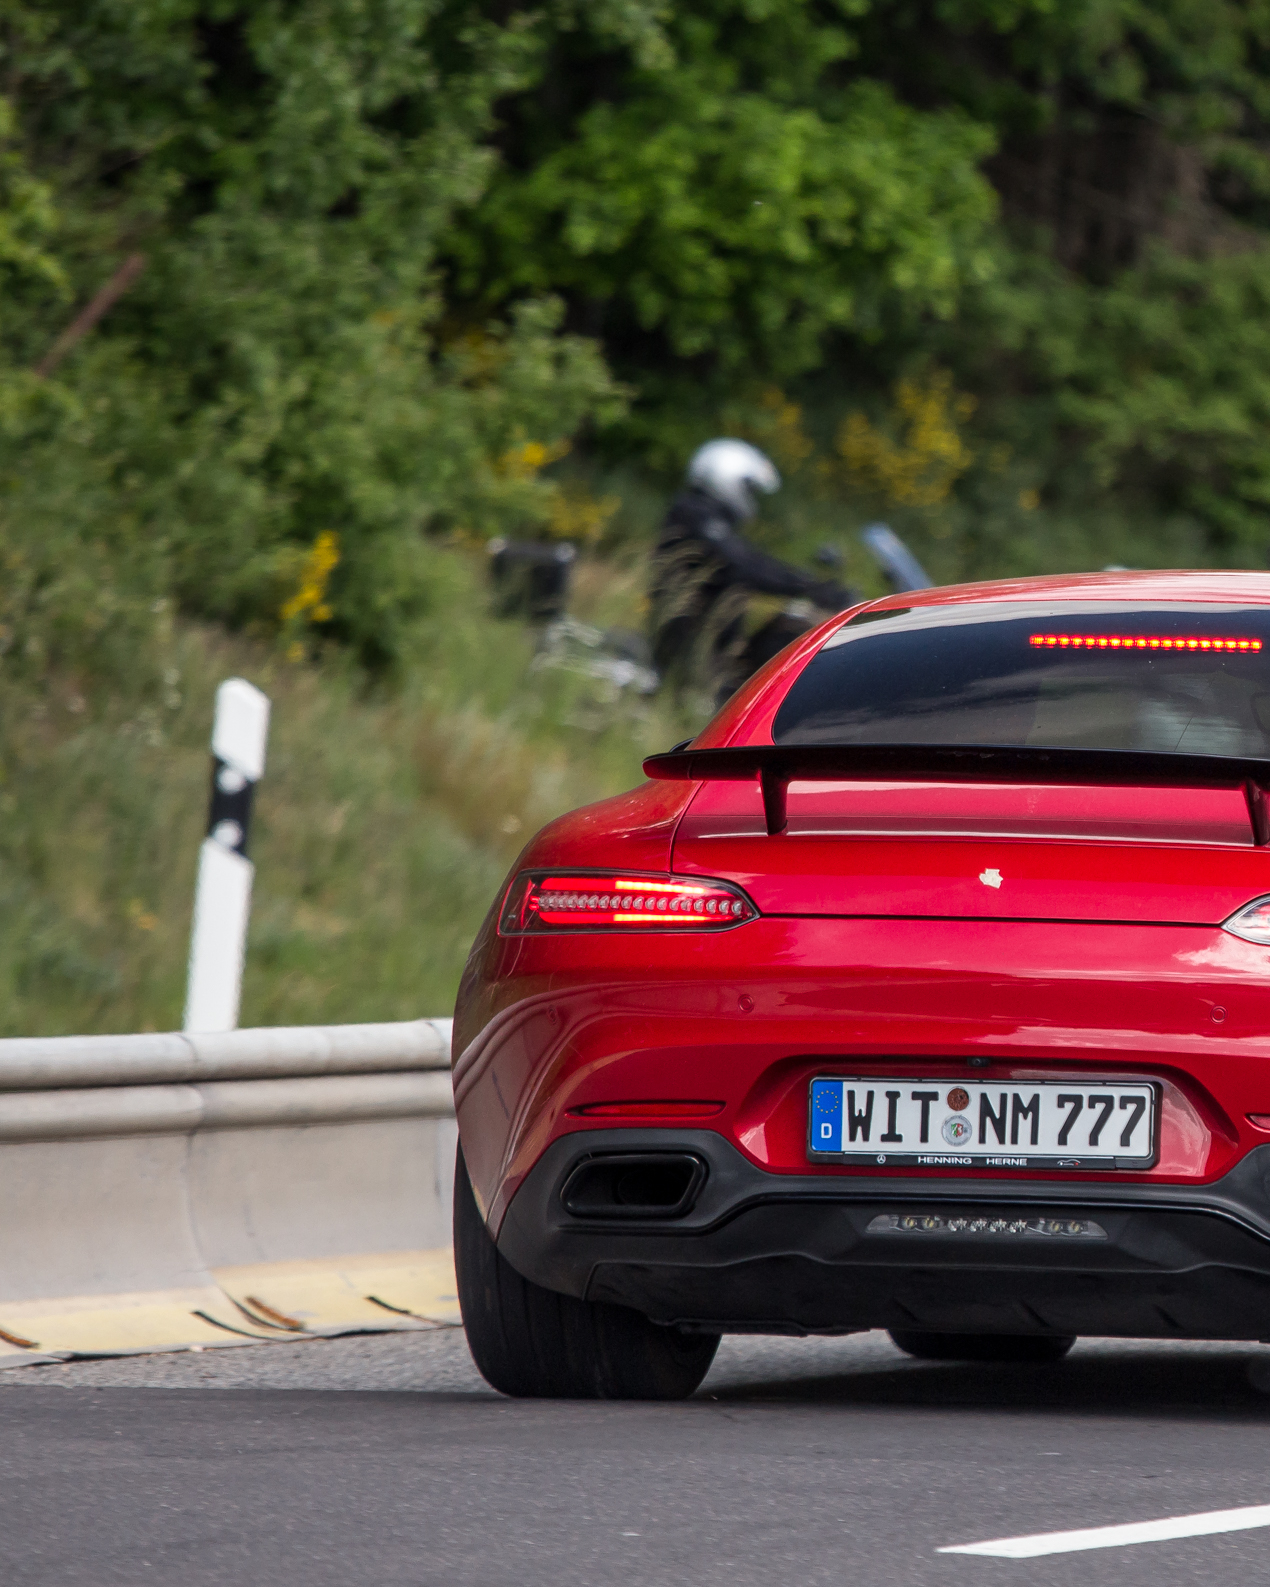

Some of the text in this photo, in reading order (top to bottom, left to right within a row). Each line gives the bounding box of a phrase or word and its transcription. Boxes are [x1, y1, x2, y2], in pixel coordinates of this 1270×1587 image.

[847, 1089, 939, 1143] WIT
[978, 1092, 1041, 1145] NM
[1057, 1094, 1147, 1147] 777
[820, 1122, 833, 1139] D
[918, 1156, 1028, 1166] HENNING HERNE
